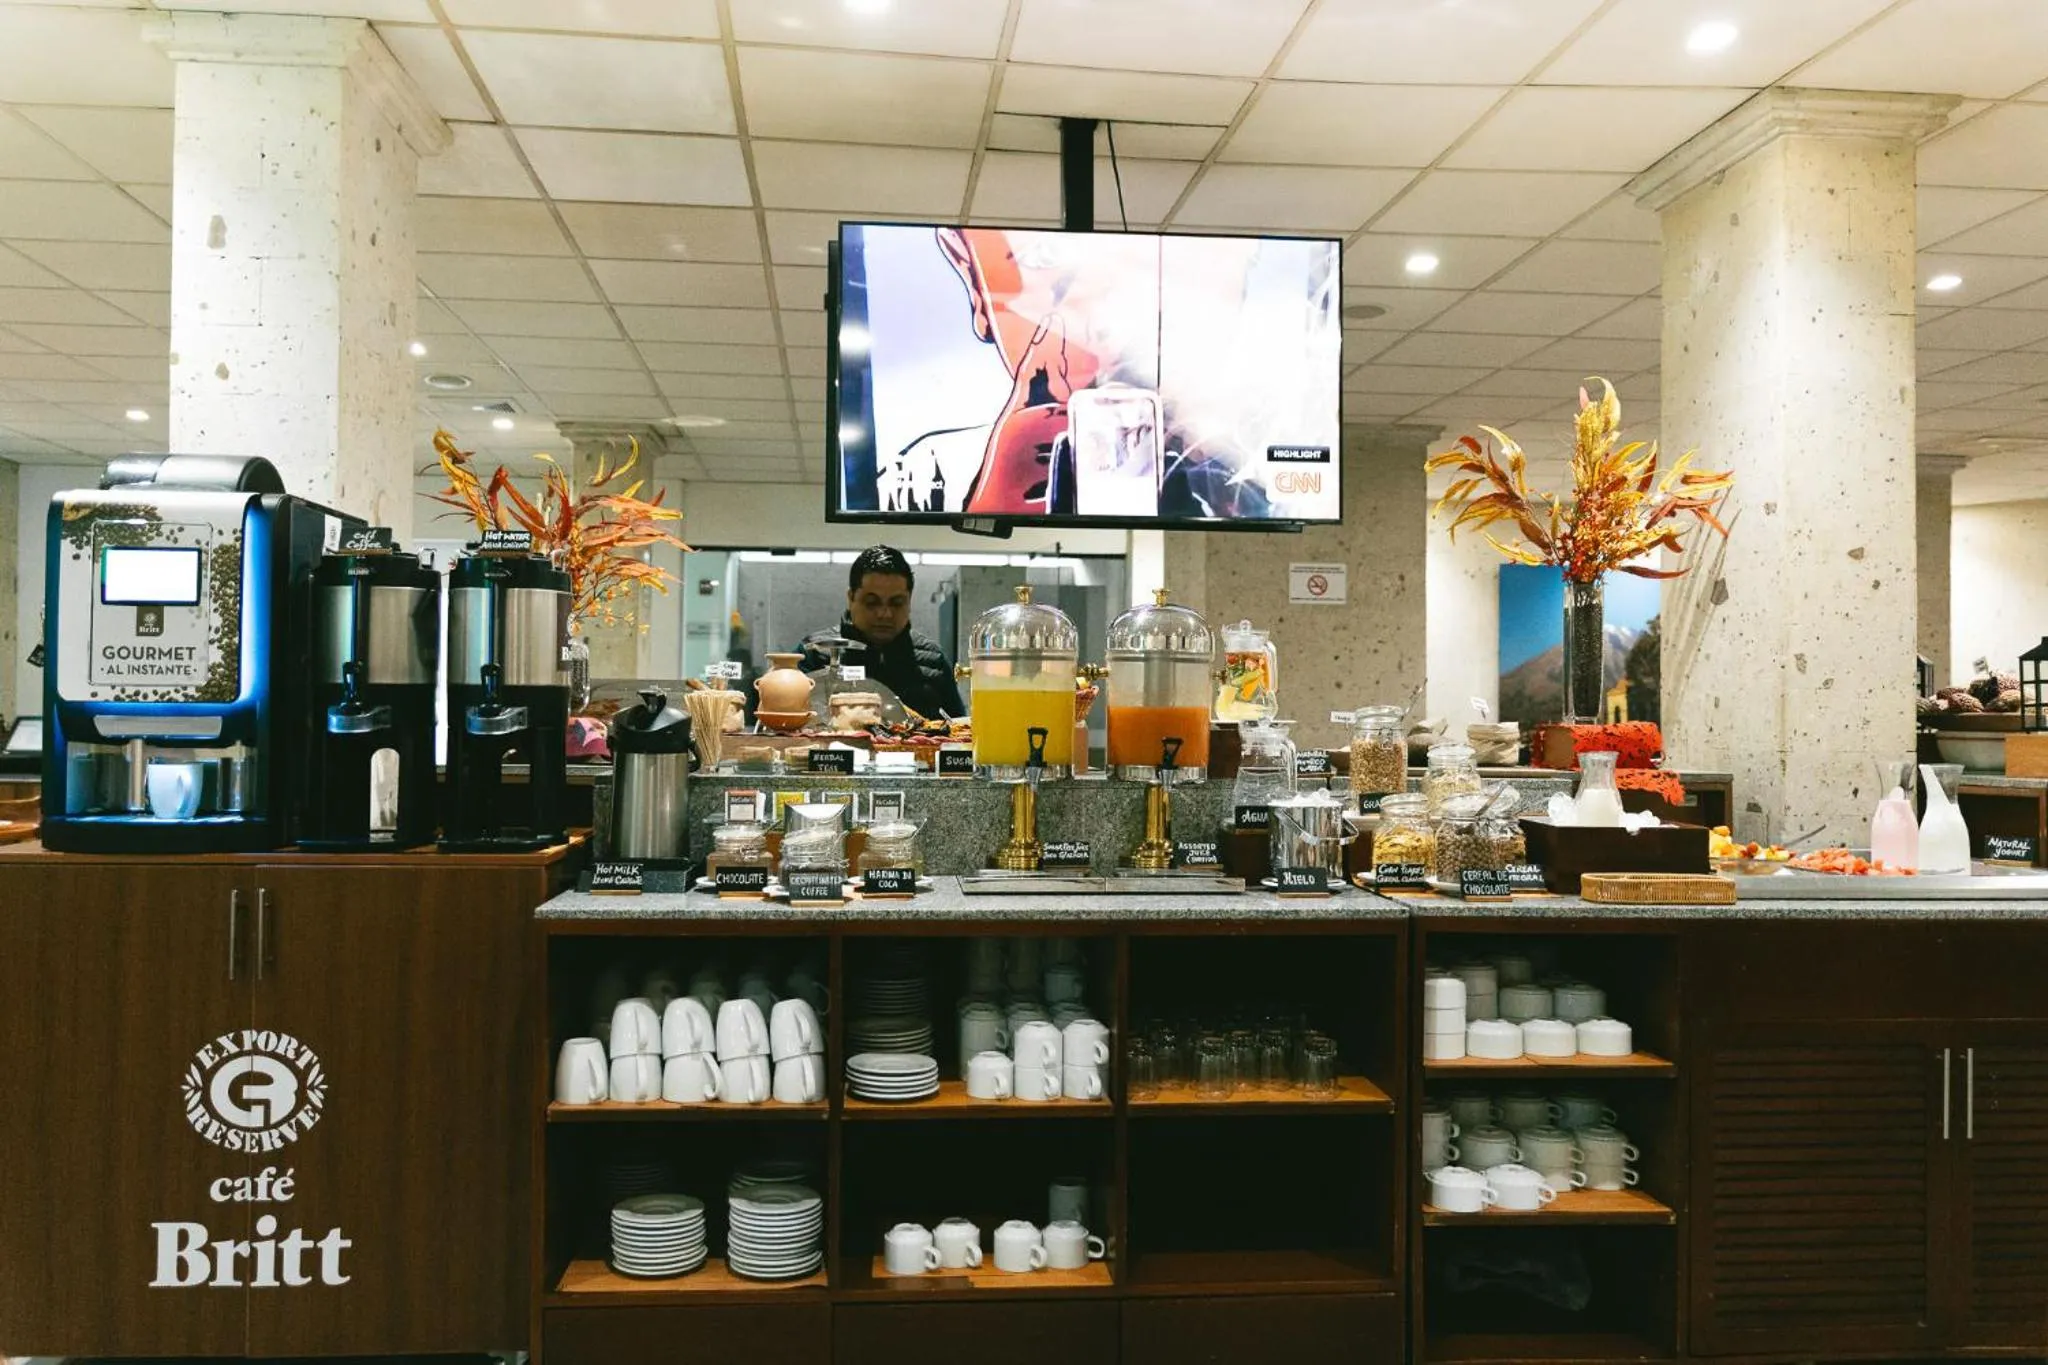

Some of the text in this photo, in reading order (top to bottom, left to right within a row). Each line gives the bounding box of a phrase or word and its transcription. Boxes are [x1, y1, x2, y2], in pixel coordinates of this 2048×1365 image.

[1273, 449, 1321, 459] HIGHLIGHT
[1275, 471, 1321, 493] CNN
[102, 645, 197, 660] GOURMET
[106, 665, 192, 675] AL INSTANTE
[946, 756, 973, 766] SUGA
[1363, 801, 1381, 810] GRA
[1988, 836, 2031, 850] NATURAL
[716, 872, 765, 884] CHOCOLATE
[1283, 871, 1315, 885] HIELO
[1462, 870, 1495, 882] CEREAL
[878, 880, 898, 889] COCA
[1463, 883, 1511, 895] CHOCOLATE
[801, 886, 829, 896] COFFEE
[196, 1029, 319, 1070] EXPORT
[186, 1103, 321, 1153] RESERVE
[210, 1166, 296, 1202] café
[148, 1214, 352, 1287] Britt
